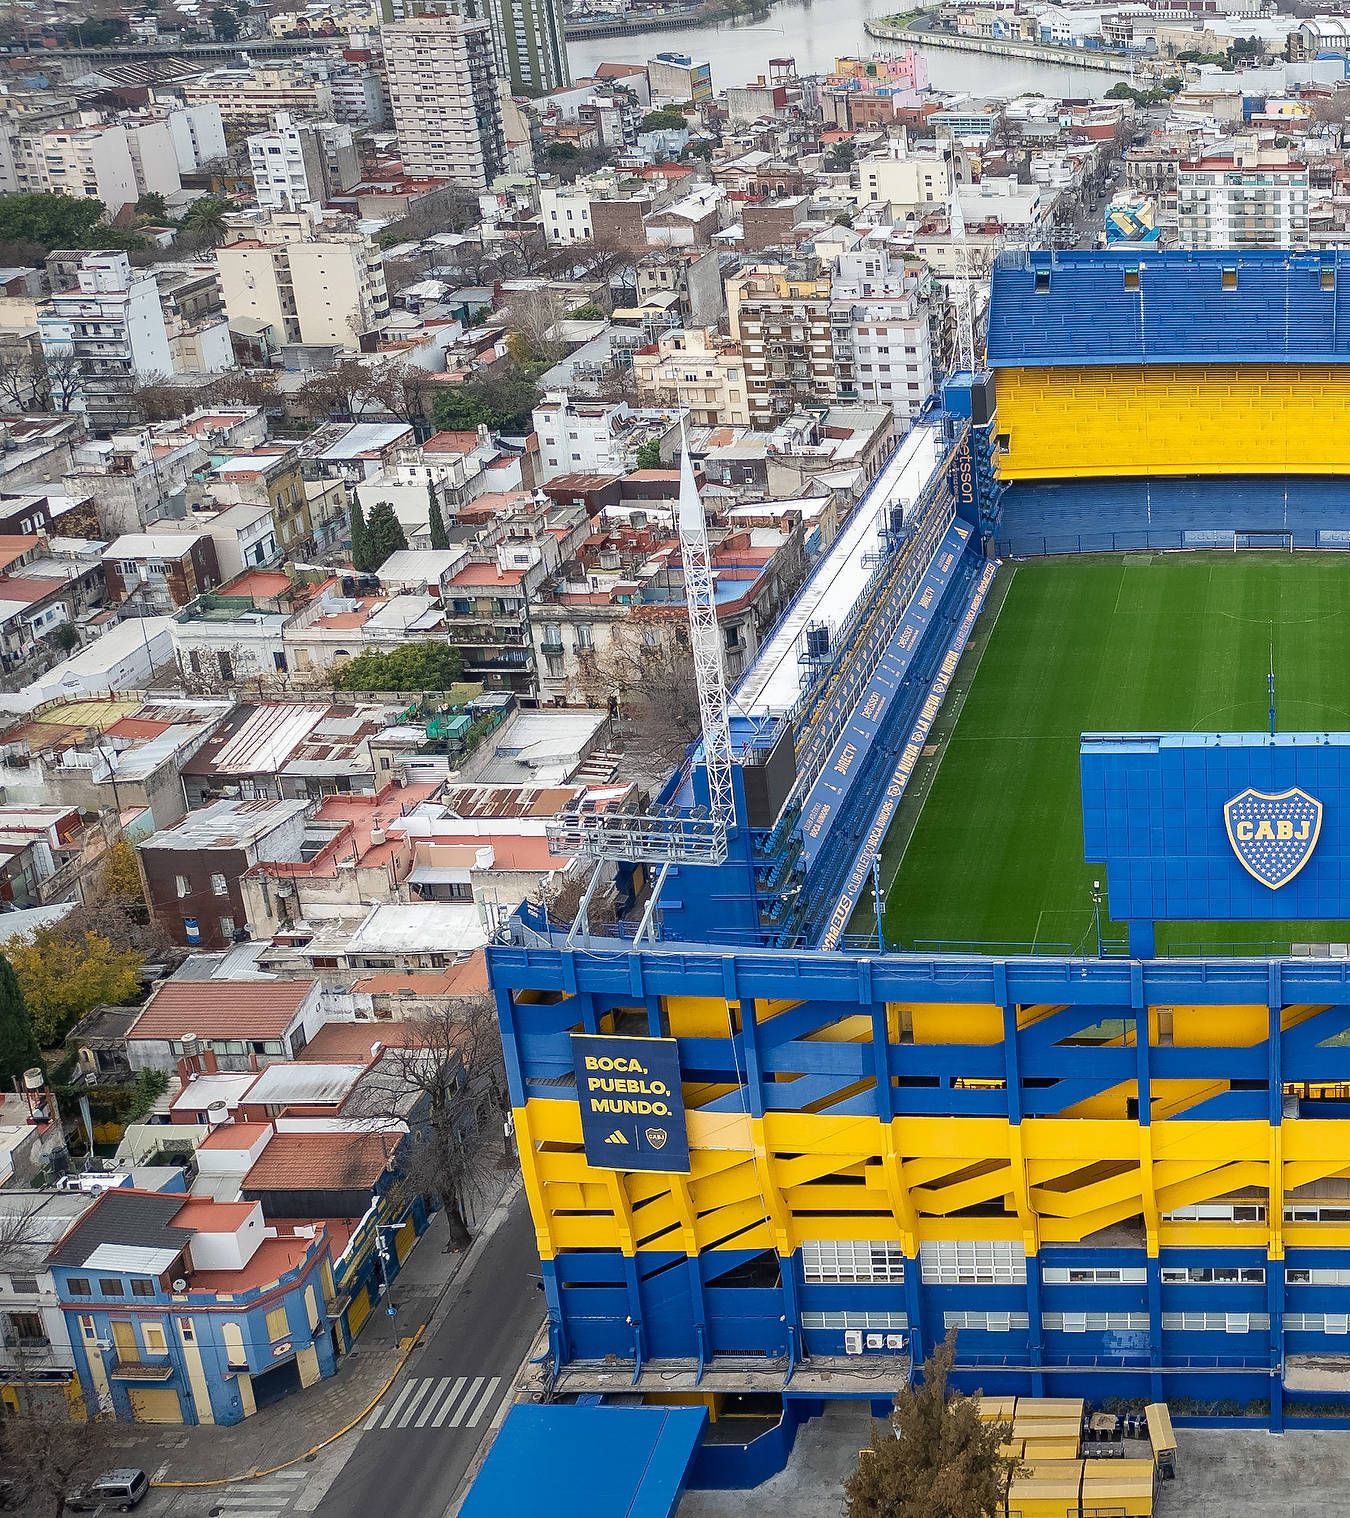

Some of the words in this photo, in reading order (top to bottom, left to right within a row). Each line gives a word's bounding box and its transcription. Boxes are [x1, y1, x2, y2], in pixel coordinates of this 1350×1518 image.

[941, 649, 959, 674] NUEVA
[937, 671, 950, 684] LA
[860, 691, 880, 719] betsson
[921, 693, 940, 720] NUEVA
[916, 719, 930, 732] LA
[834, 743, 858, 775] DIRECTV
[898, 743, 919, 773] NUEVA
[892, 772, 907, 786] LA
[1237, 820, 1310, 840] CABJ
[848, 873, 862, 893] CLUB
[869, 827, 882, 845] BOCA
[876, 801, 893, 827] JUNIORS
[585, 1056, 648, 1075] BOCA,
[587, 1077, 671, 1096] PUEBLO,
[590, 1098, 673, 1116] MUNDO.
